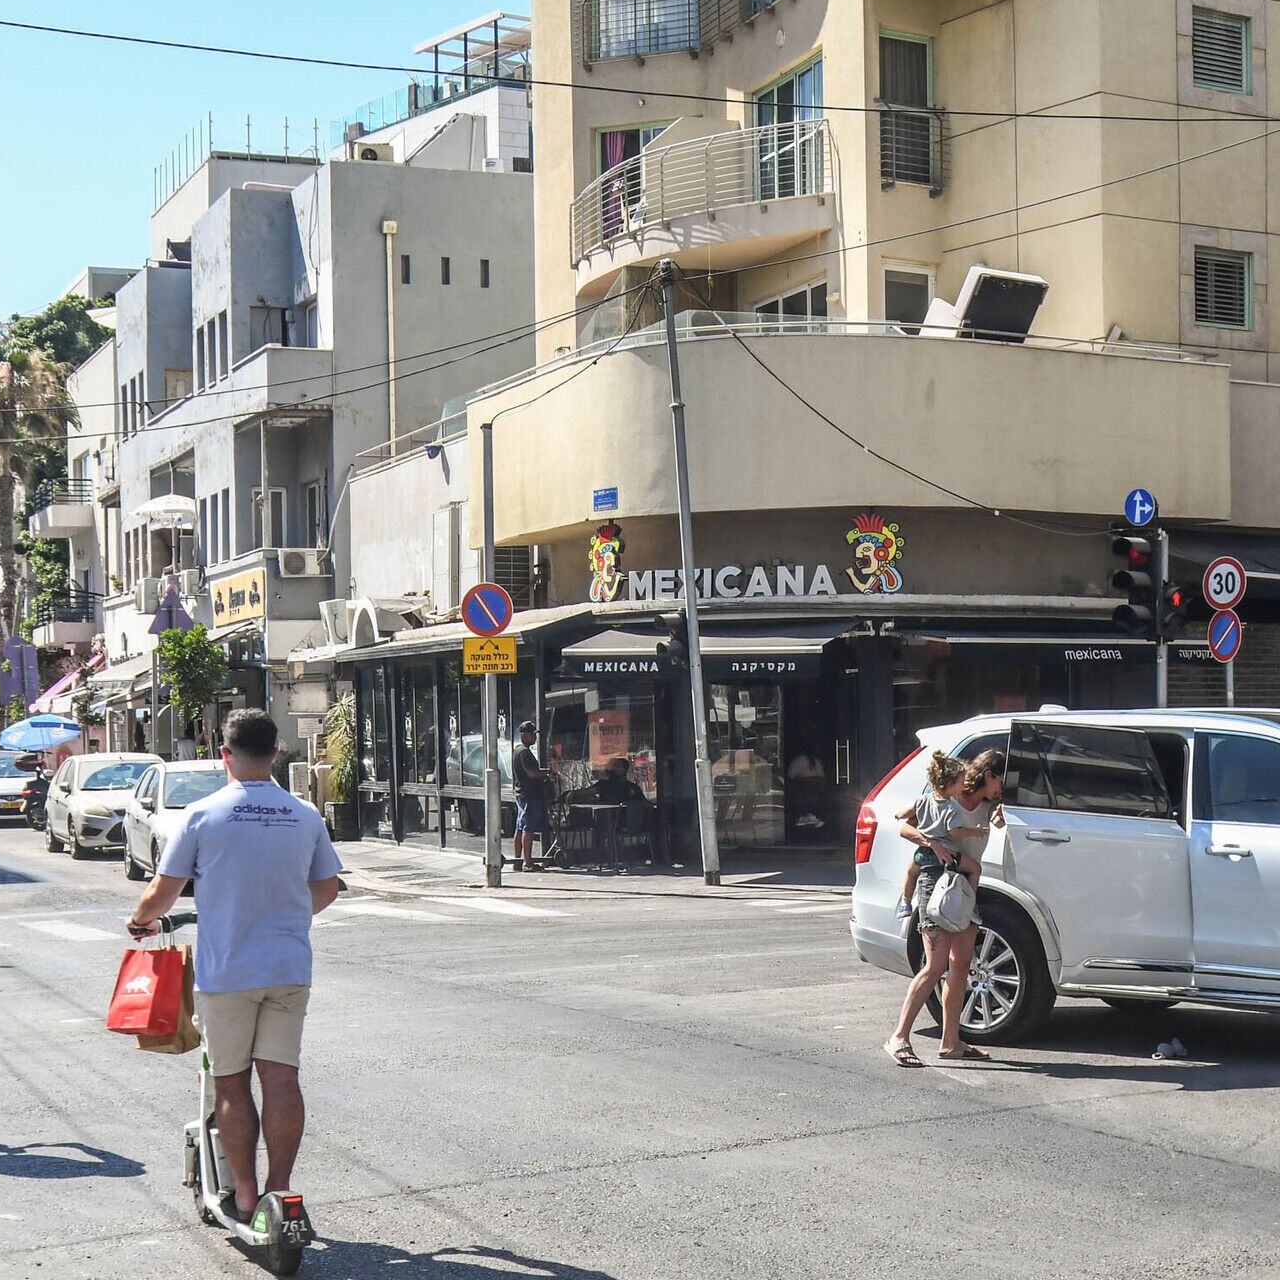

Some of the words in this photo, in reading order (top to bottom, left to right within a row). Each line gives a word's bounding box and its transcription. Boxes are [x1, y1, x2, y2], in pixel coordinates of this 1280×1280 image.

[628, 564, 837, 601] MEXICANA
[1212, 571, 1236, 596] 30
[470, 654, 492, 662] מעקה
[493, 653, 514, 661] כולל
[1064, 648, 1123, 661] mexicana
[482, 663, 499, 671] חונה
[500, 663, 514, 671] רכב
[584, 661, 659, 672] MEXICANA
[731, 662, 796, 672] מקסיקנה
[233, 804, 277, 815] adidas
[281, 1220, 308, 1233] 761
